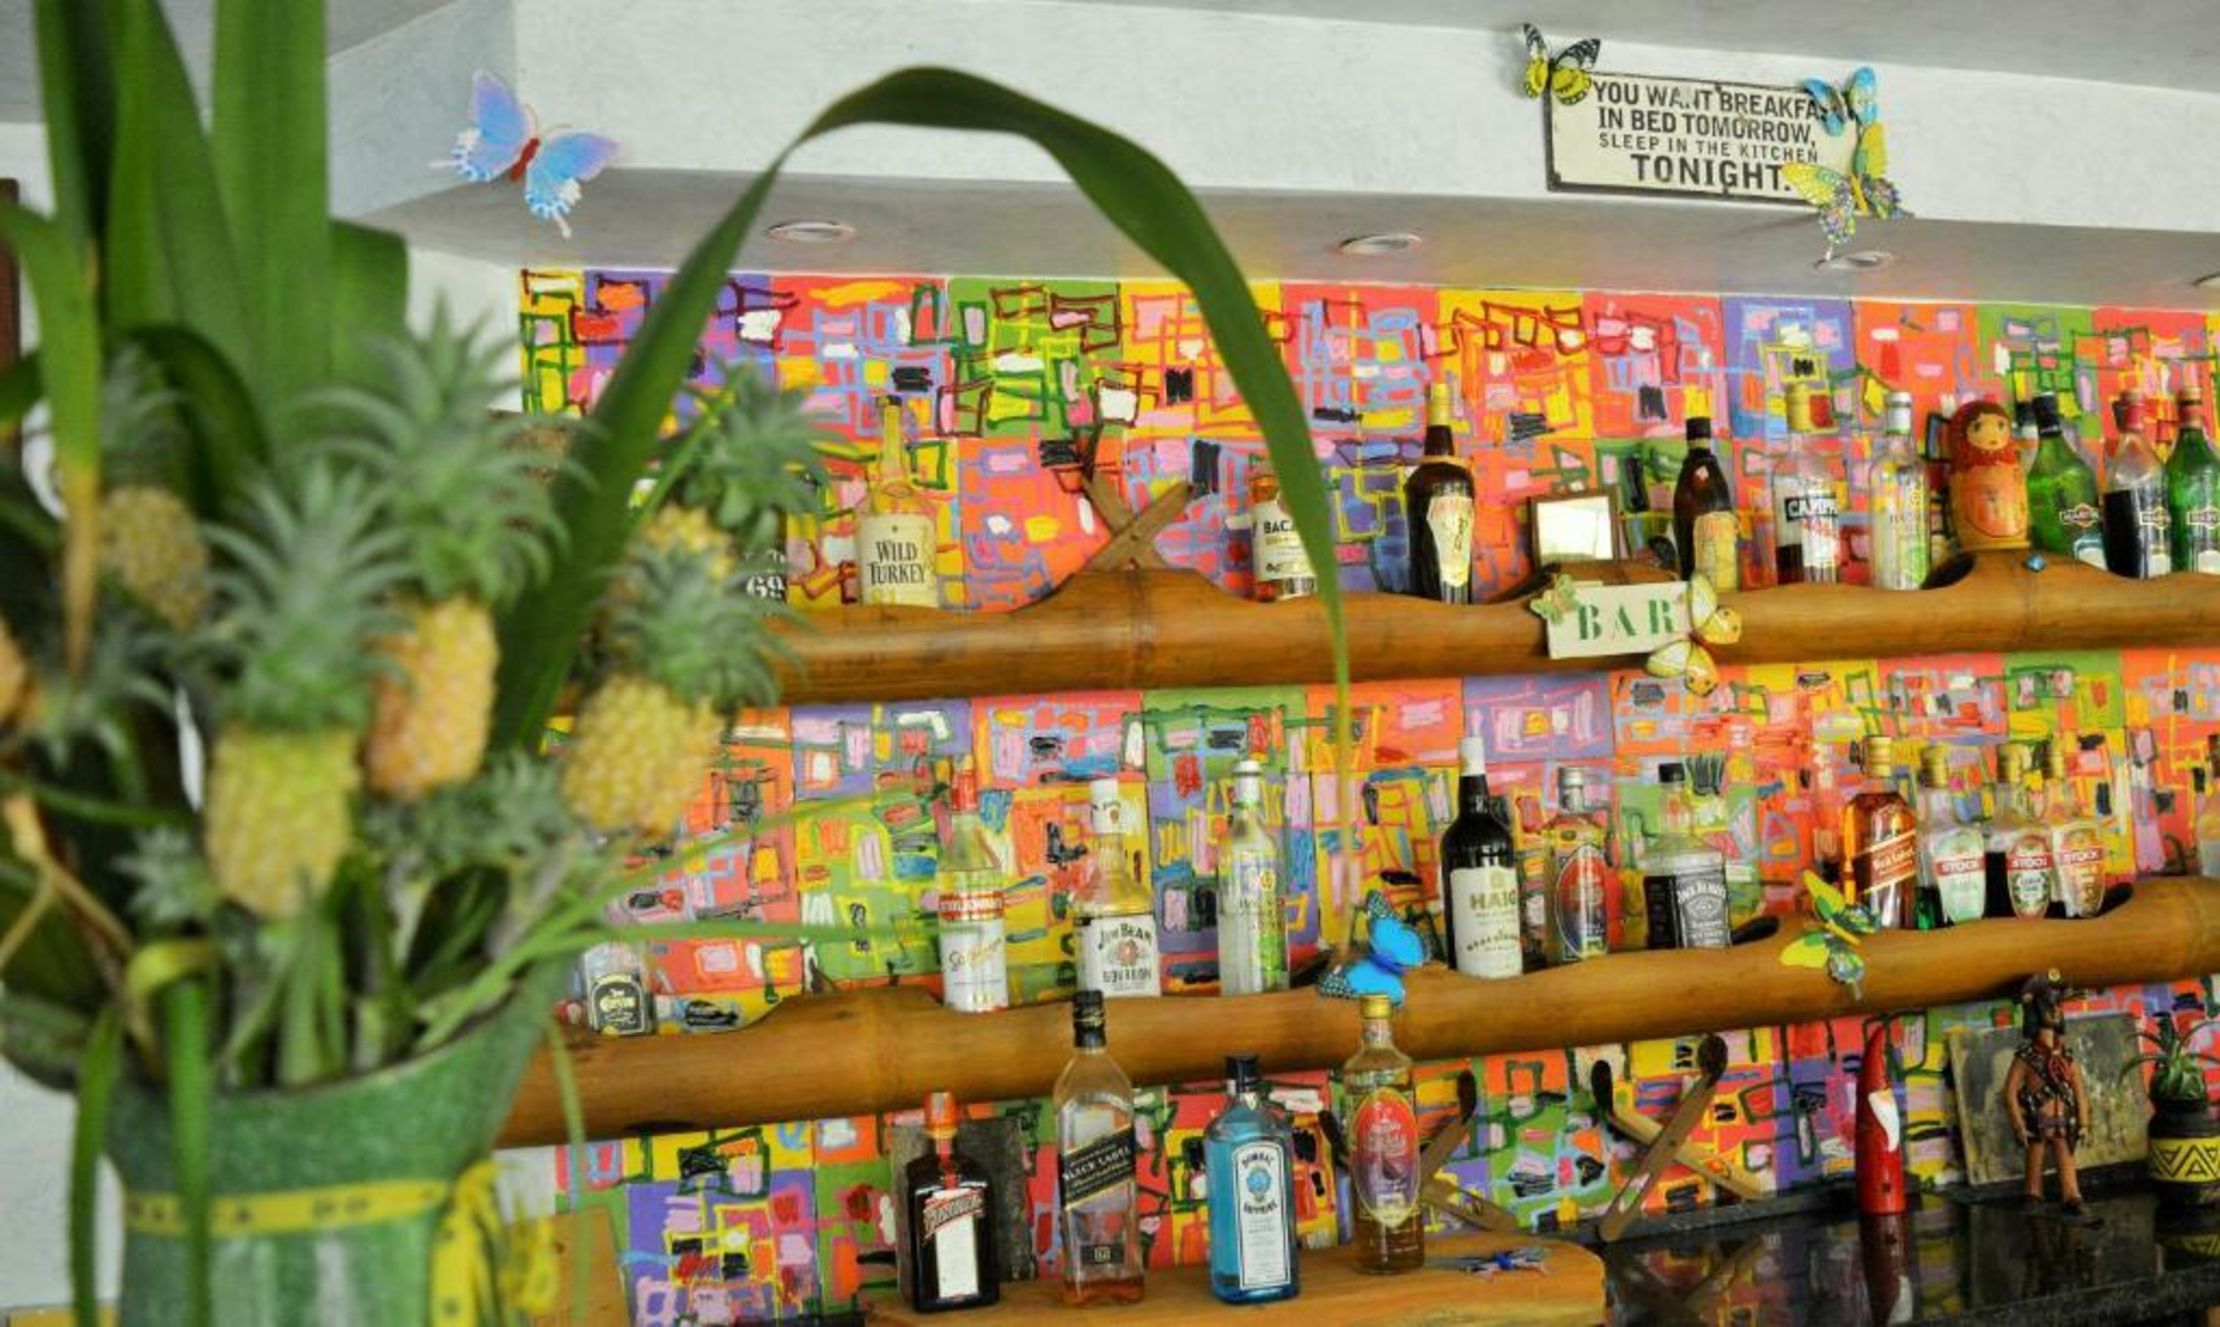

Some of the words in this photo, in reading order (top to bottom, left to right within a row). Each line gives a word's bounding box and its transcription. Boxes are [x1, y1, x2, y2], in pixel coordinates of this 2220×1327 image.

[1593, 81, 1639, 105] YOU
[1646, 84, 1714, 111] WANT
[1719, 90, 1820, 120] BREAKFA
[1598, 106, 1623, 130] IN
[1631, 109, 1677, 134] BED
[1681, 113, 1816, 148] TOMORROW,
[1599, 132, 1660, 151] SLEEP
[1668, 137, 1688, 153] IN
[1695, 140, 1732, 157] THE
[1739, 143, 1819, 164] KITCHEN
[1630, 153, 1793, 192] TONIGHT.
[875, 540, 919, 563] WILD
[746, 574, 786, 599] 69
[867, 560, 927, 586] TURKEY
[1577, 598, 1676, 641] BAR
